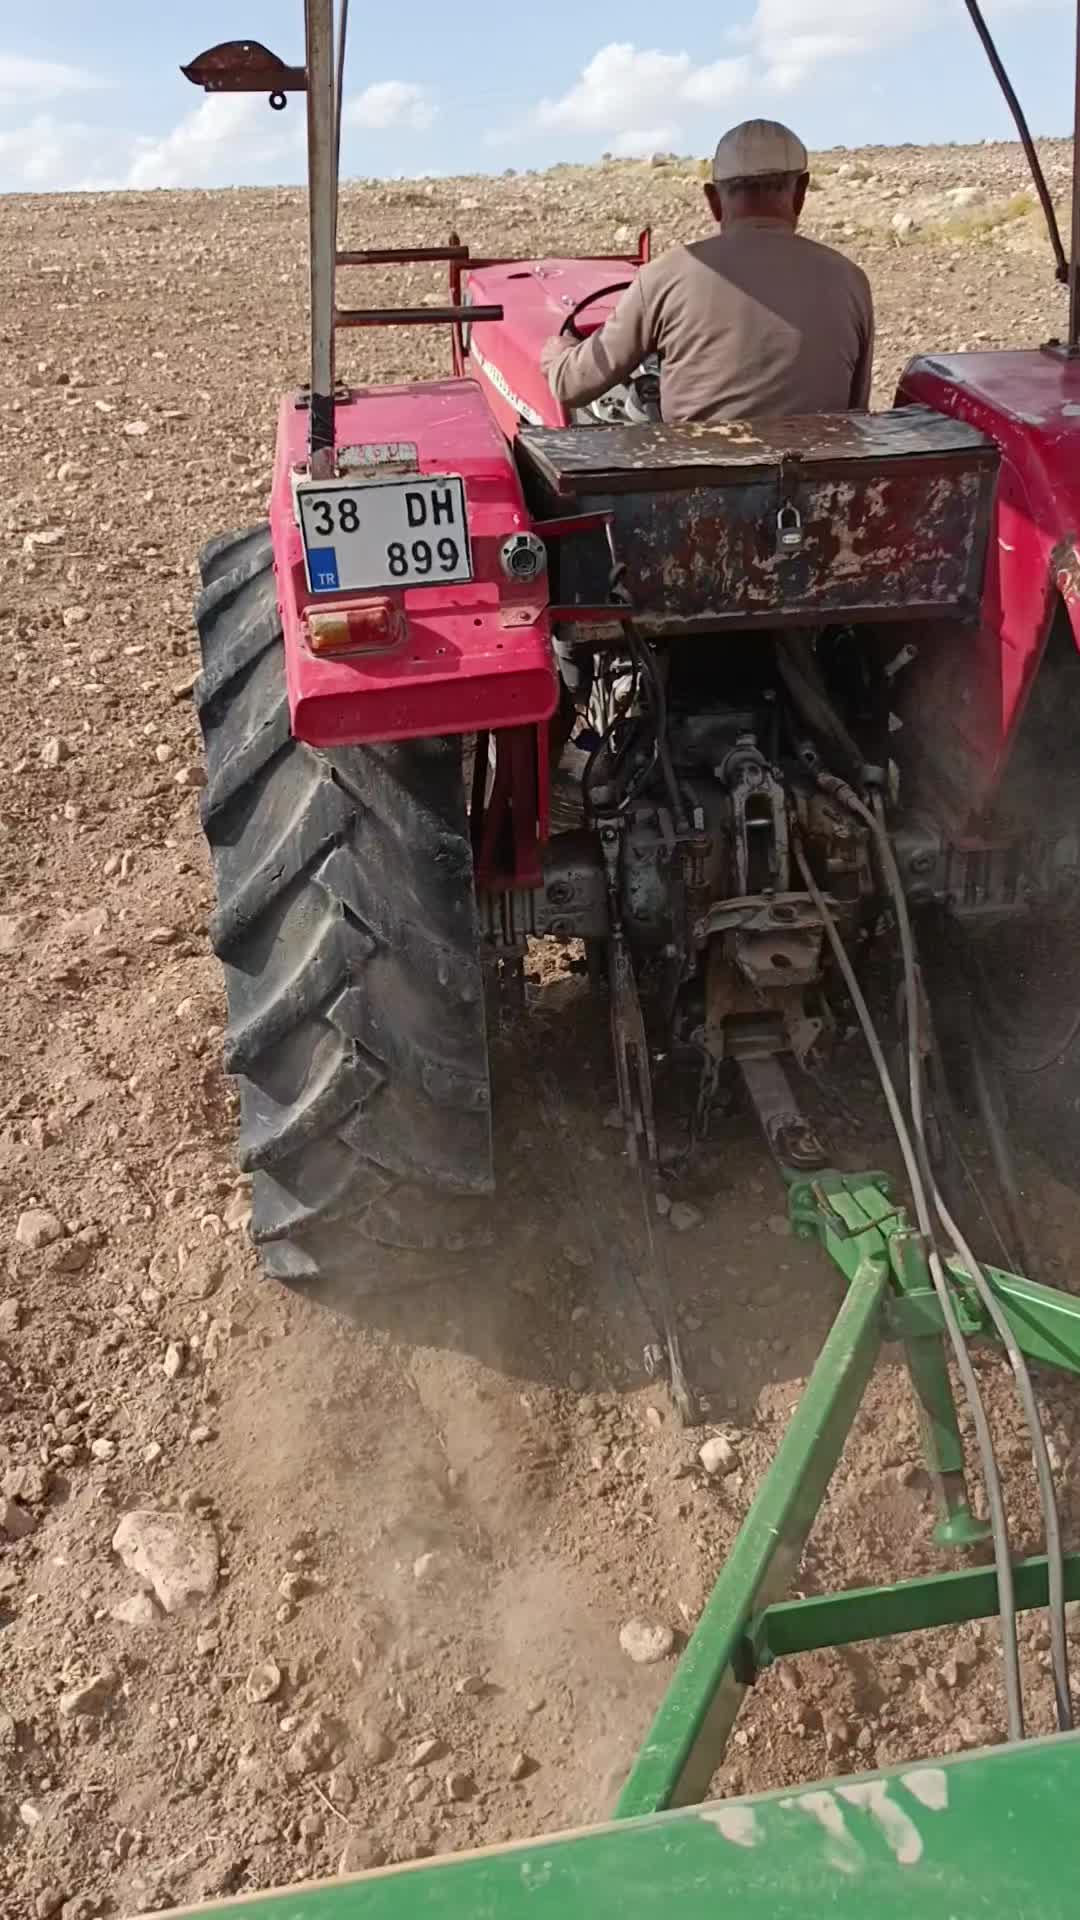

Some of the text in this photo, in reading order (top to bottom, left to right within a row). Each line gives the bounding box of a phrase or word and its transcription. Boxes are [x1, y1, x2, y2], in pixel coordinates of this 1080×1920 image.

[312, 489, 455, 536] 38 DH
[387, 537, 459, 577] 899
[317, 573, 337, 585] TR
